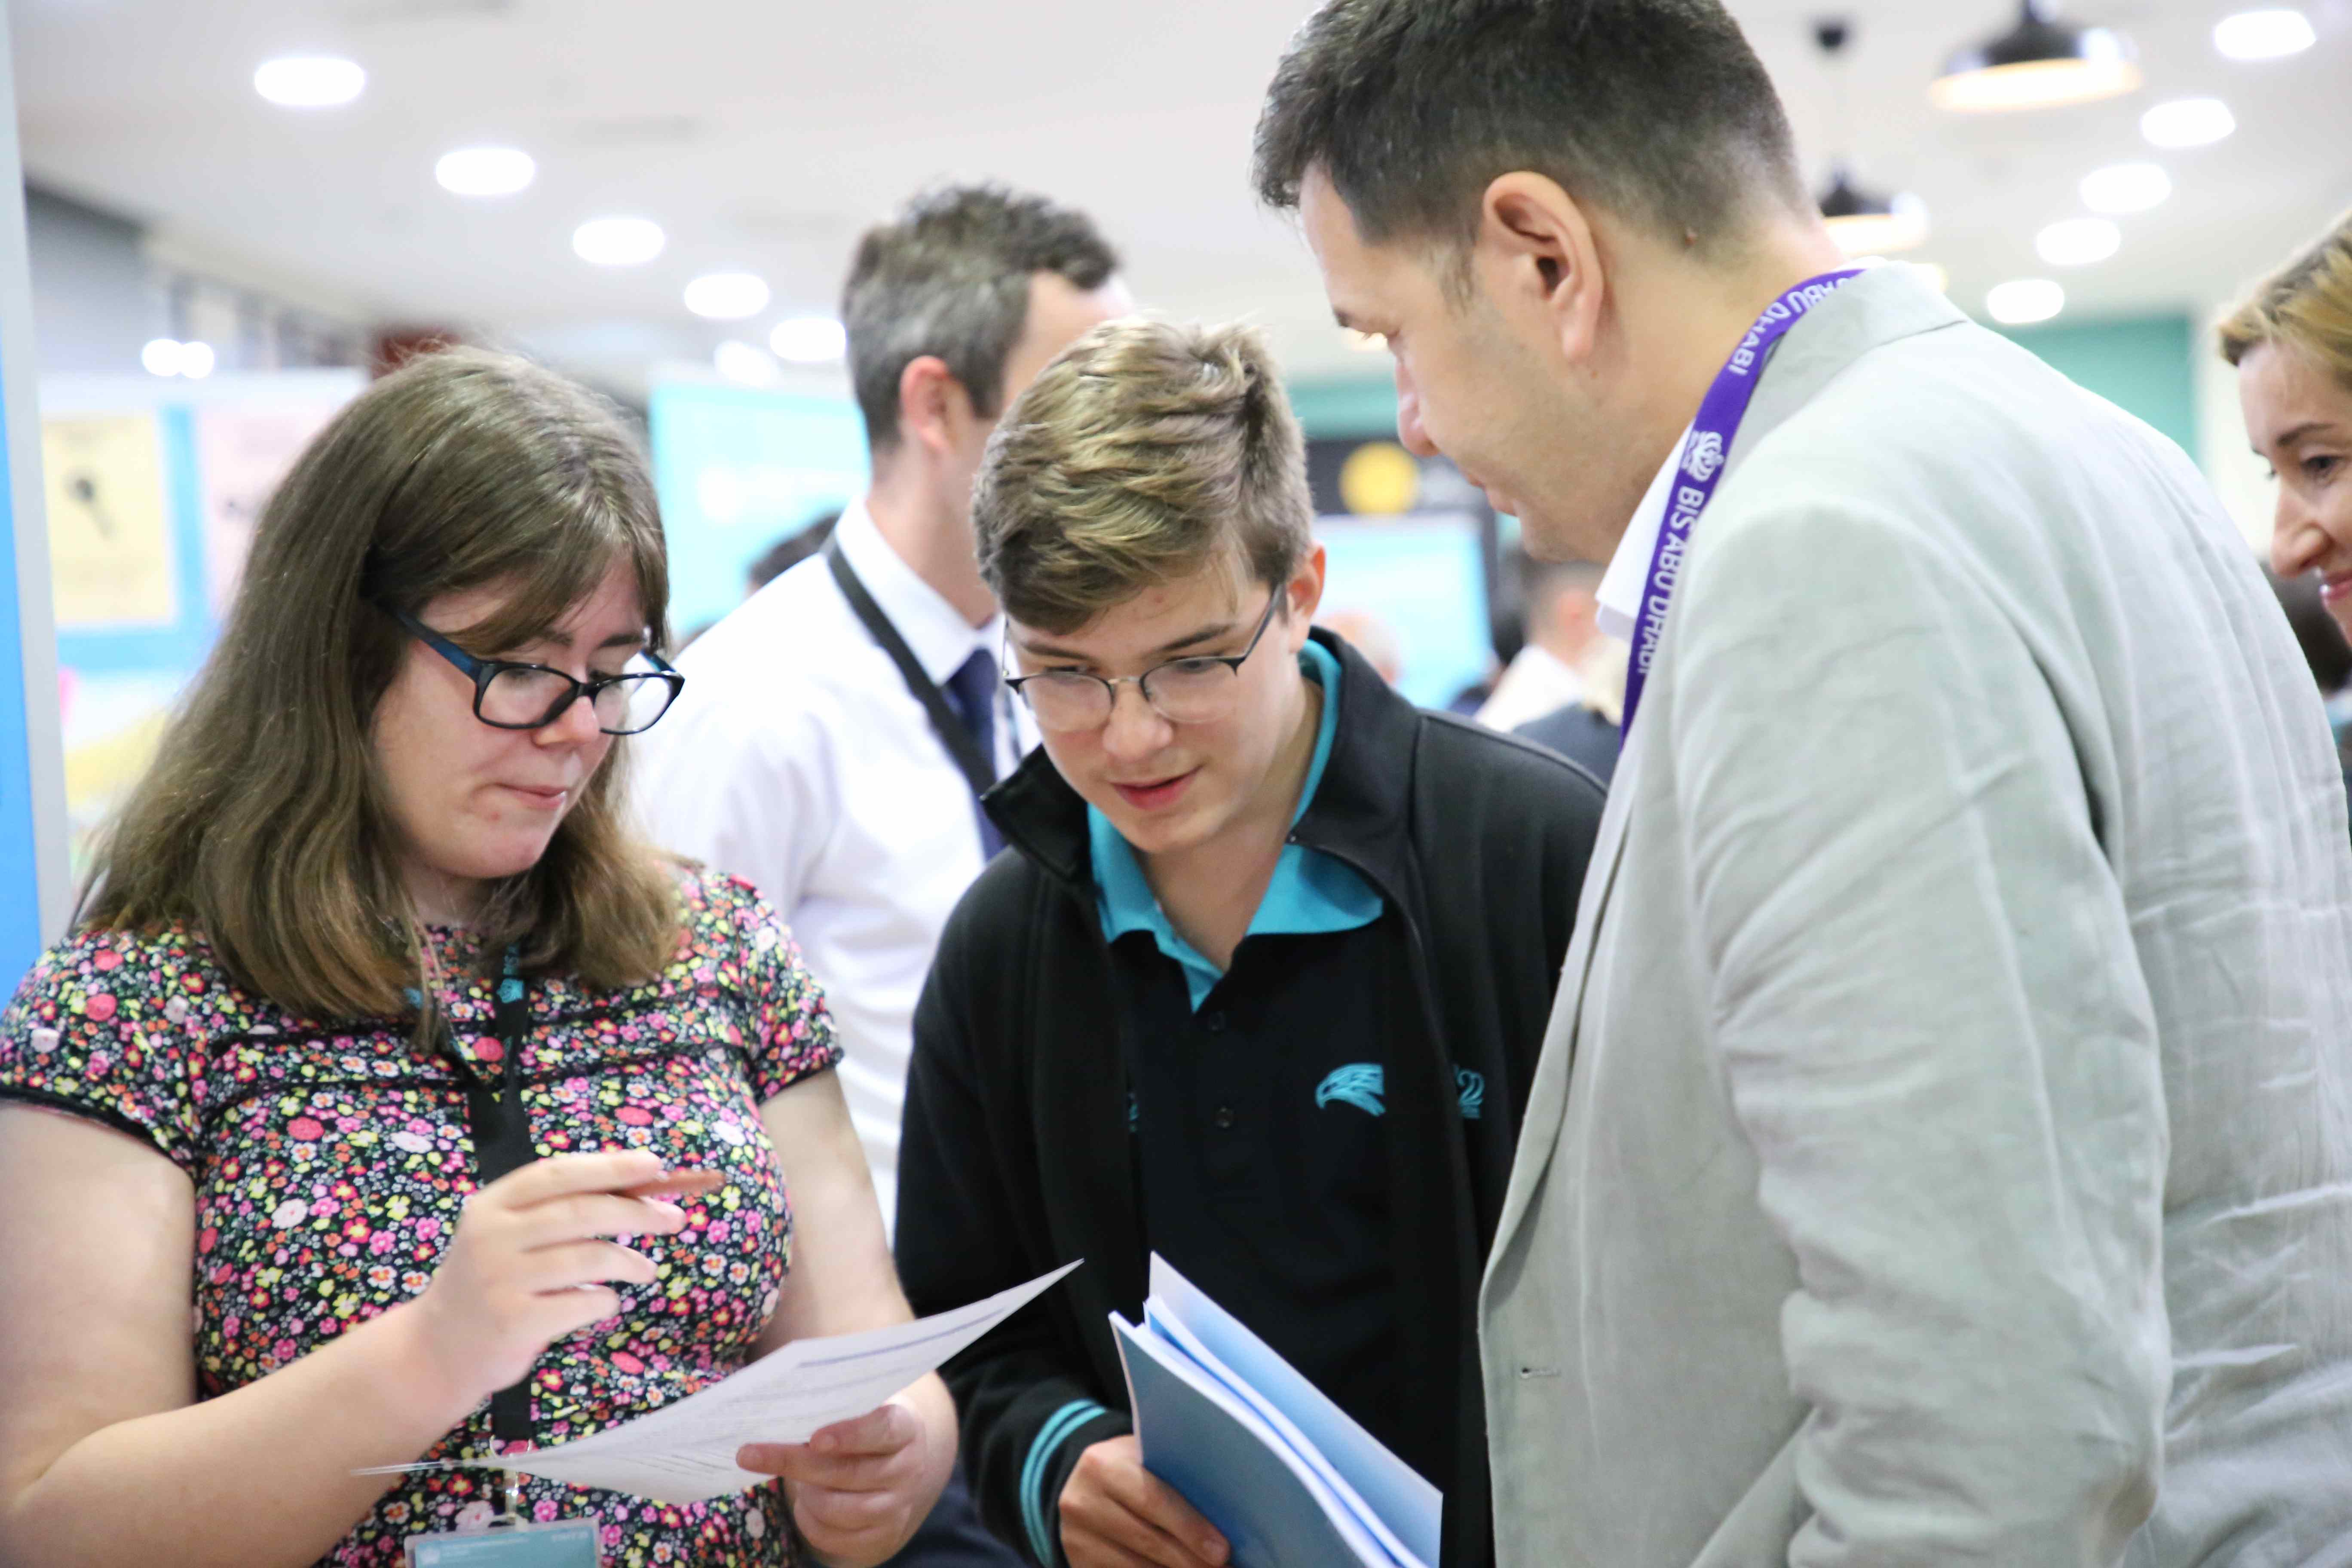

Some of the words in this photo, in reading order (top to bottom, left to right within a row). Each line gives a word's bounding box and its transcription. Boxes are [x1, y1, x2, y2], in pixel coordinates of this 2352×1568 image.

[1728, 301, 1791, 376] DHABI
[1669, 486, 1706, 531] BIS
[1654, 532, 1688, 591] ABU
